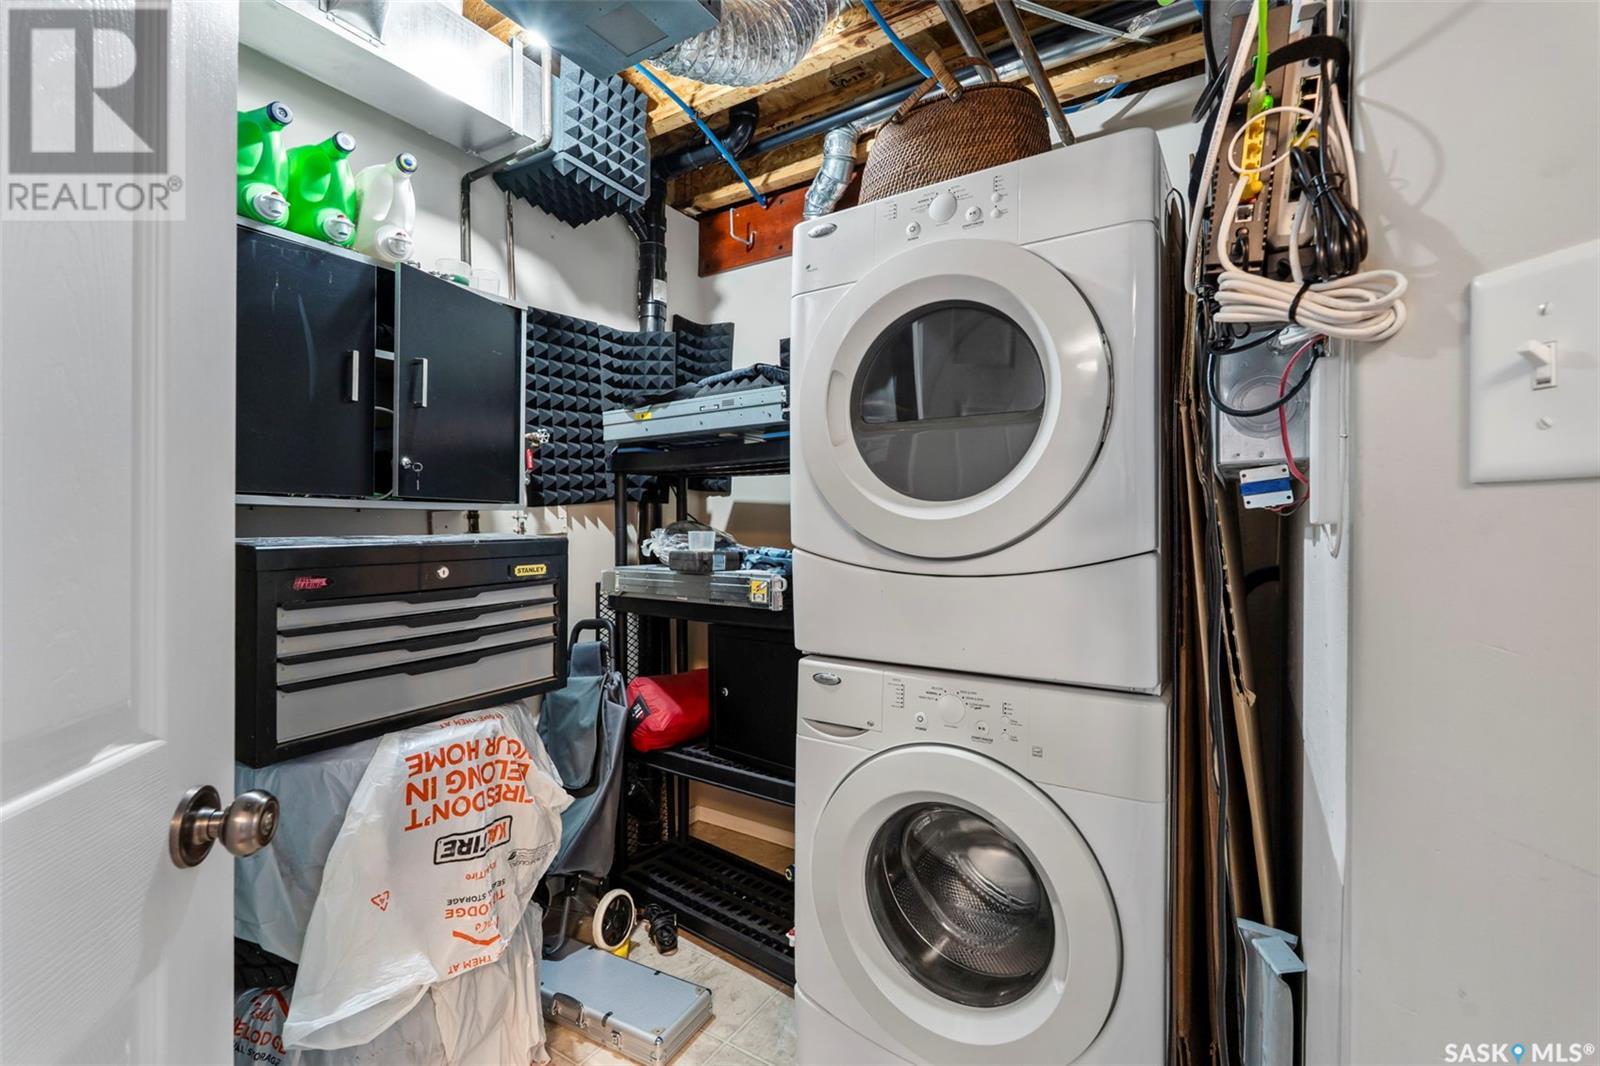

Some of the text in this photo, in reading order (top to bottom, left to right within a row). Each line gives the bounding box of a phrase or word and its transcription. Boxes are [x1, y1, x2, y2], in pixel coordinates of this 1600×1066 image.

[517, 566, 544, 574] STANLEY
[405, 739, 480, 778] HOME
[405, 776, 437, 806] IN
[404, 790, 486, 831] DON'T
[446, 892, 487, 906] STORAGE
[447, 963, 460, 975] AT
[463, 955, 493, 969] THEM
